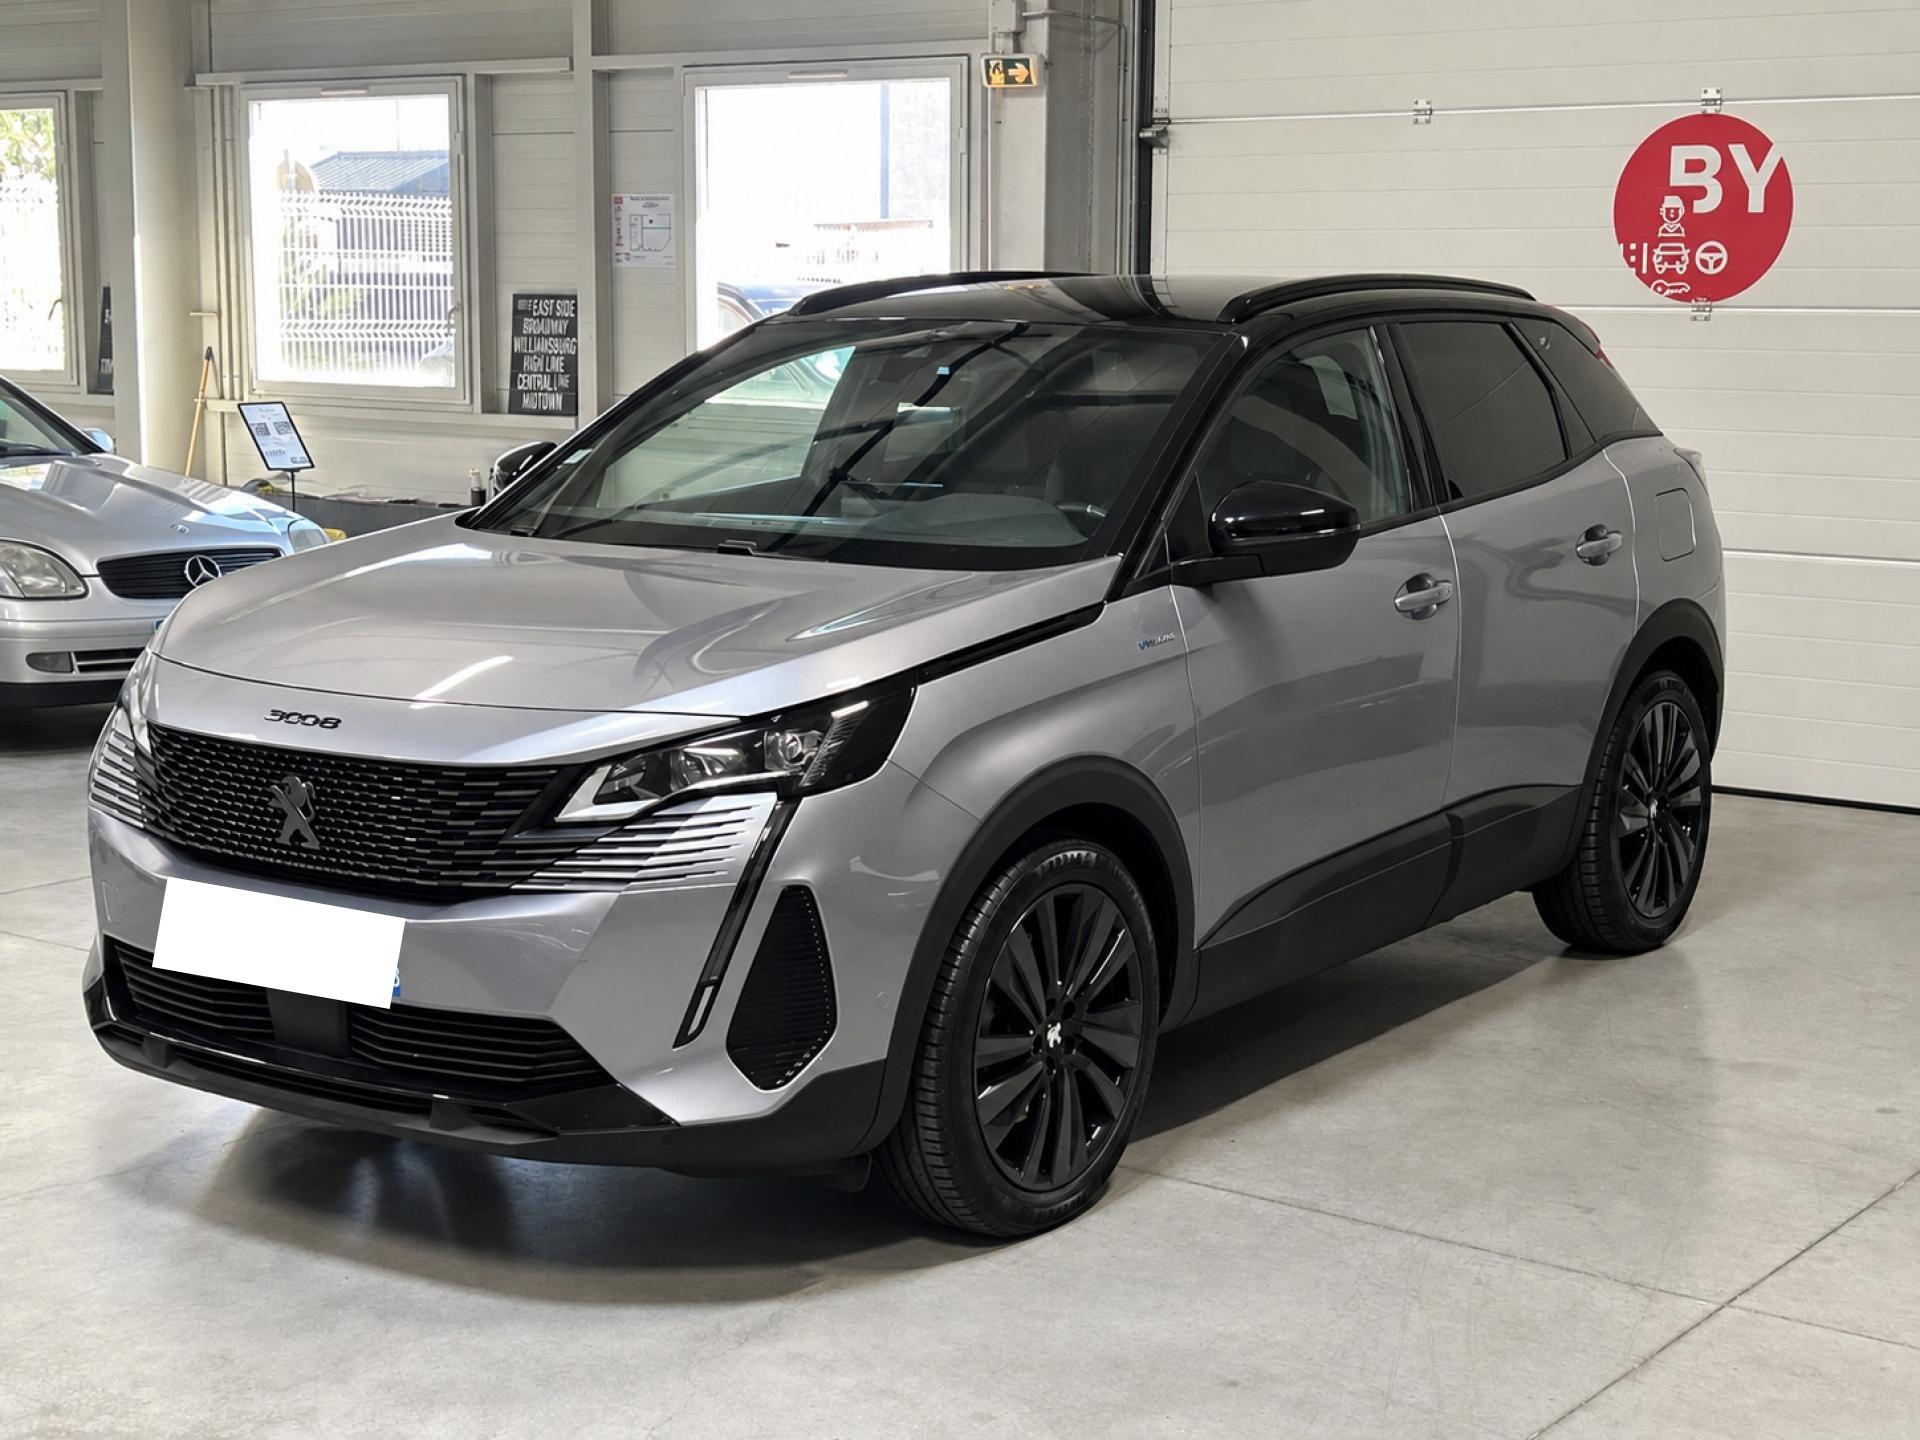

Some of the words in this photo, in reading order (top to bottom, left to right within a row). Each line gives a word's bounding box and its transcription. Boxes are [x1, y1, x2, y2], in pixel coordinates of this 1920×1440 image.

[1669, 143, 1783, 214] BY
[532, 298, 555, 317] EAST
[555, 299, 576, 318] SIDE
[264, 709, 342, 729] 3008
